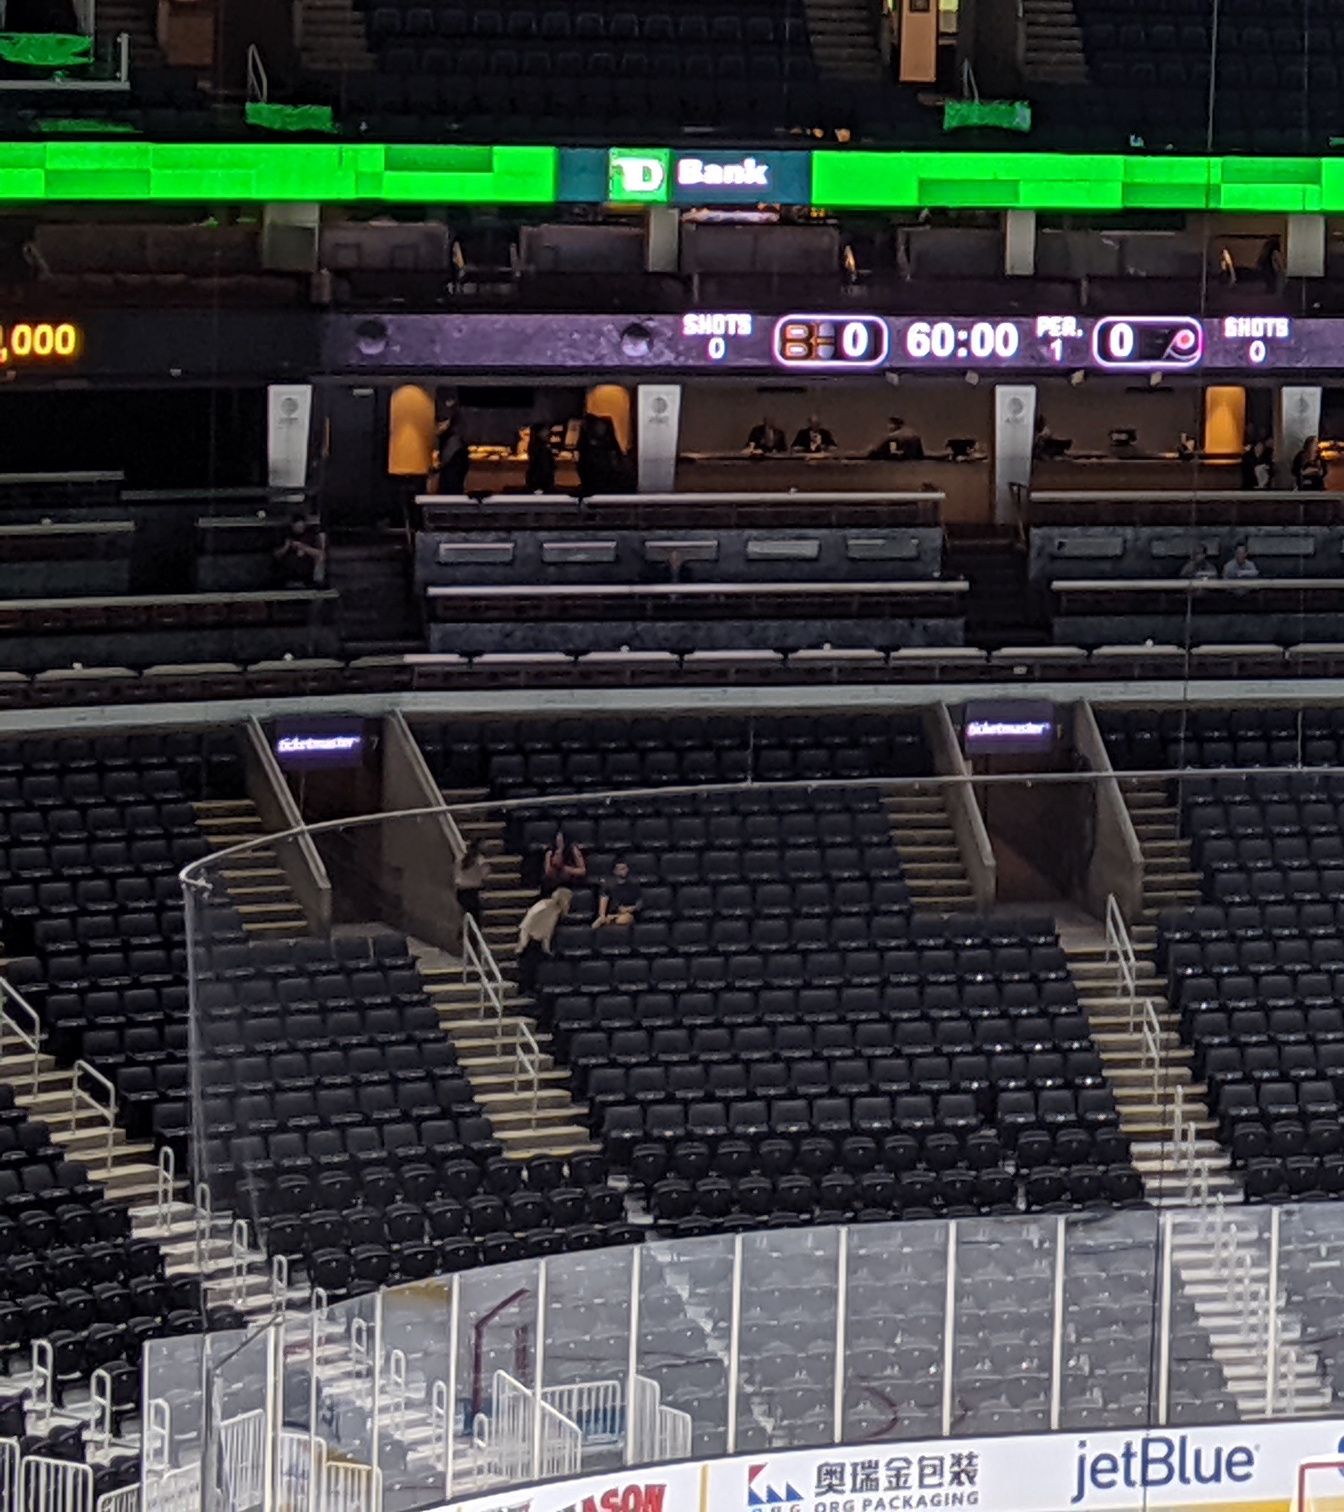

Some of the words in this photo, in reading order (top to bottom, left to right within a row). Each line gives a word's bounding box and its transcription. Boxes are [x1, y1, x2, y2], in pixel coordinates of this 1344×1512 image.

[676, 159, 768, 187] Bank
[683, 314, 752, 336] SHOTS
[842, 322, 869, 358] 0
[906, 322, 1019, 358] 60:00
[1036, 316, 1084, 338] PER.
[1108, 322, 1134, 358] 0
[1225, 317, 1289, 338] SHOTS
[708, 338, 726, 360] 0
[1050, 340, 1064, 363] 1
[1248, 340, 1267, 363] 0
[815, 1451, 980, 1496] 奥瑞金包装
[1070, 1436, 1257, 1504] jetBlue
[863, 1491, 981, 1511] PACKAGING
